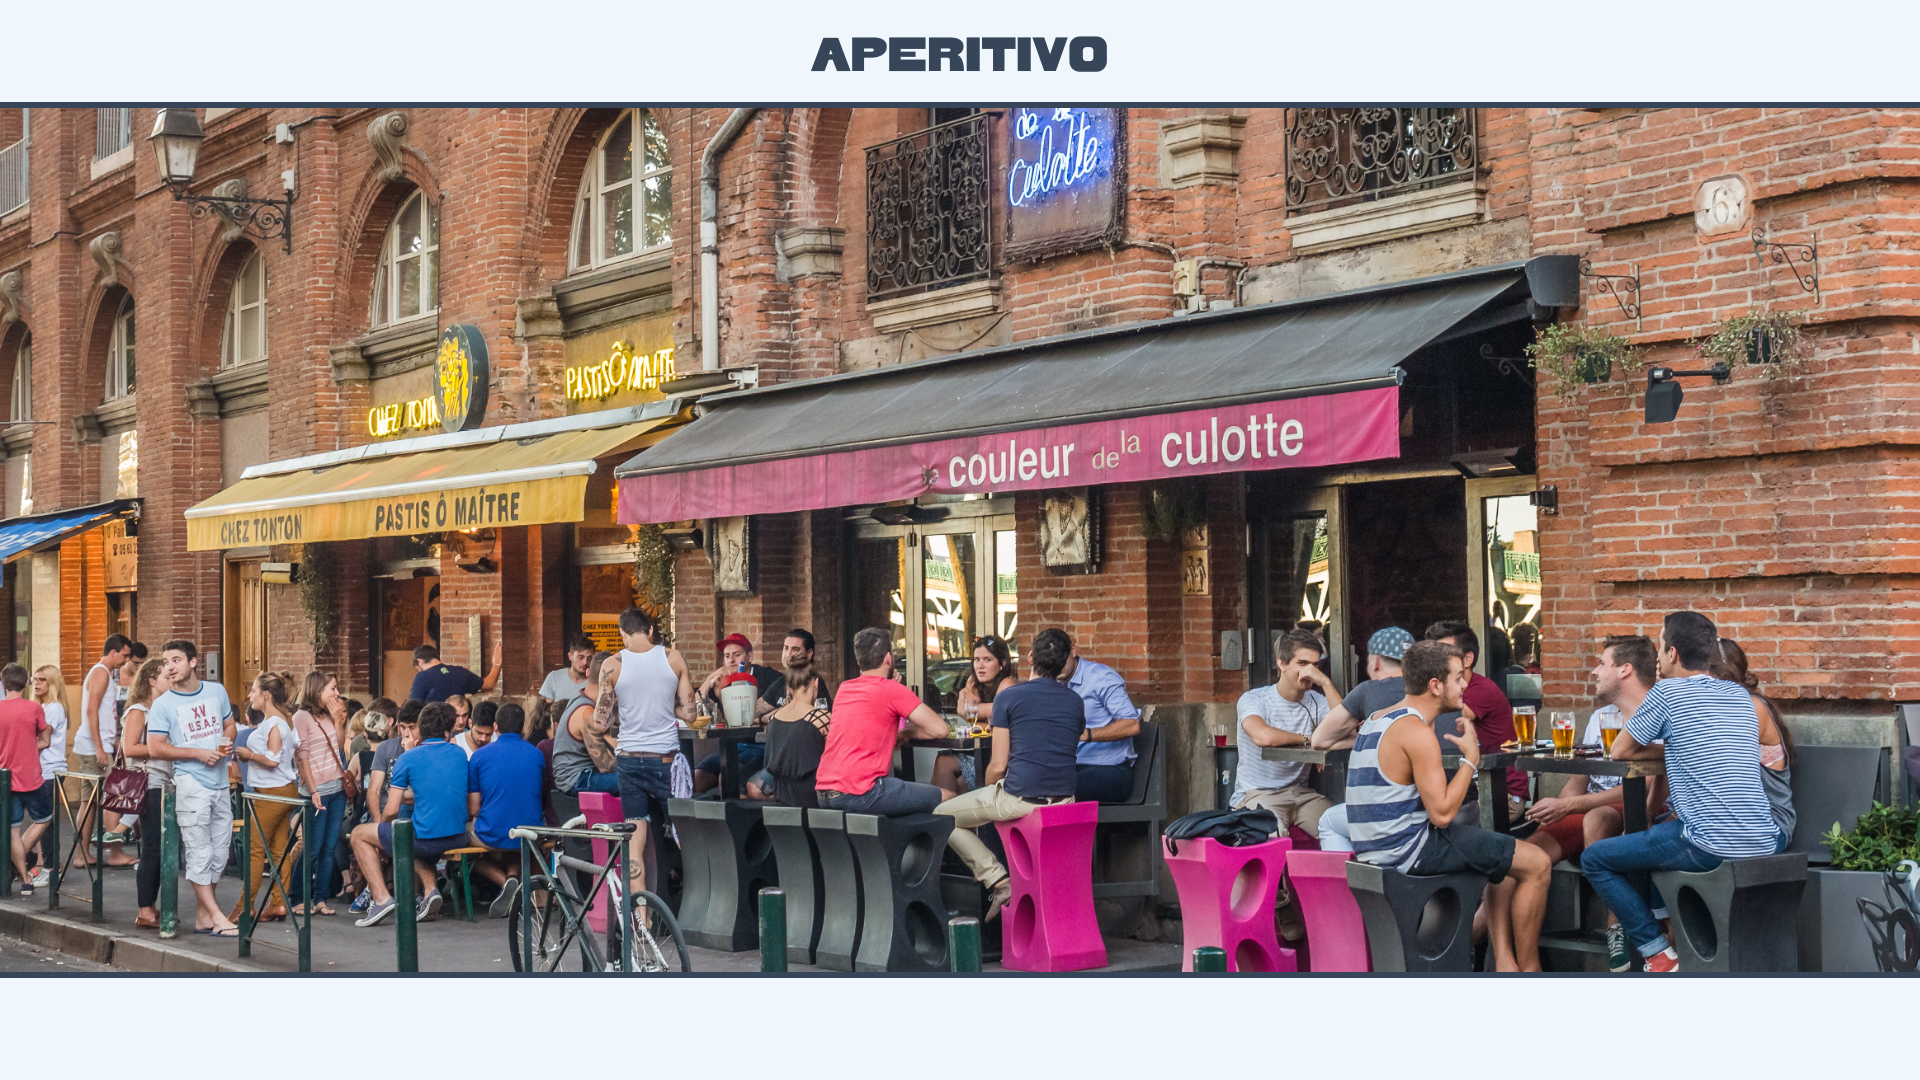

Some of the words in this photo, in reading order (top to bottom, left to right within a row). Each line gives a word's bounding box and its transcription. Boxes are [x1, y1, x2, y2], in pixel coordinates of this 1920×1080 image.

[368, 403, 399, 436] CHEZ
[948, 439, 1075, 488] couleur
[1092, 448, 1119, 470] de
[1120, 430, 1141, 455] la
[1161, 413, 1304, 468] culotte
[375, 499, 430, 532] PASTIS
[435, 491, 447, 527] Ô
[455, 487, 520, 526] MAÎTRE
[220, 518, 250, 545] CHEZ
[253, 514, 302, 542] TONTON
[191, 704, 206, 719] XV
